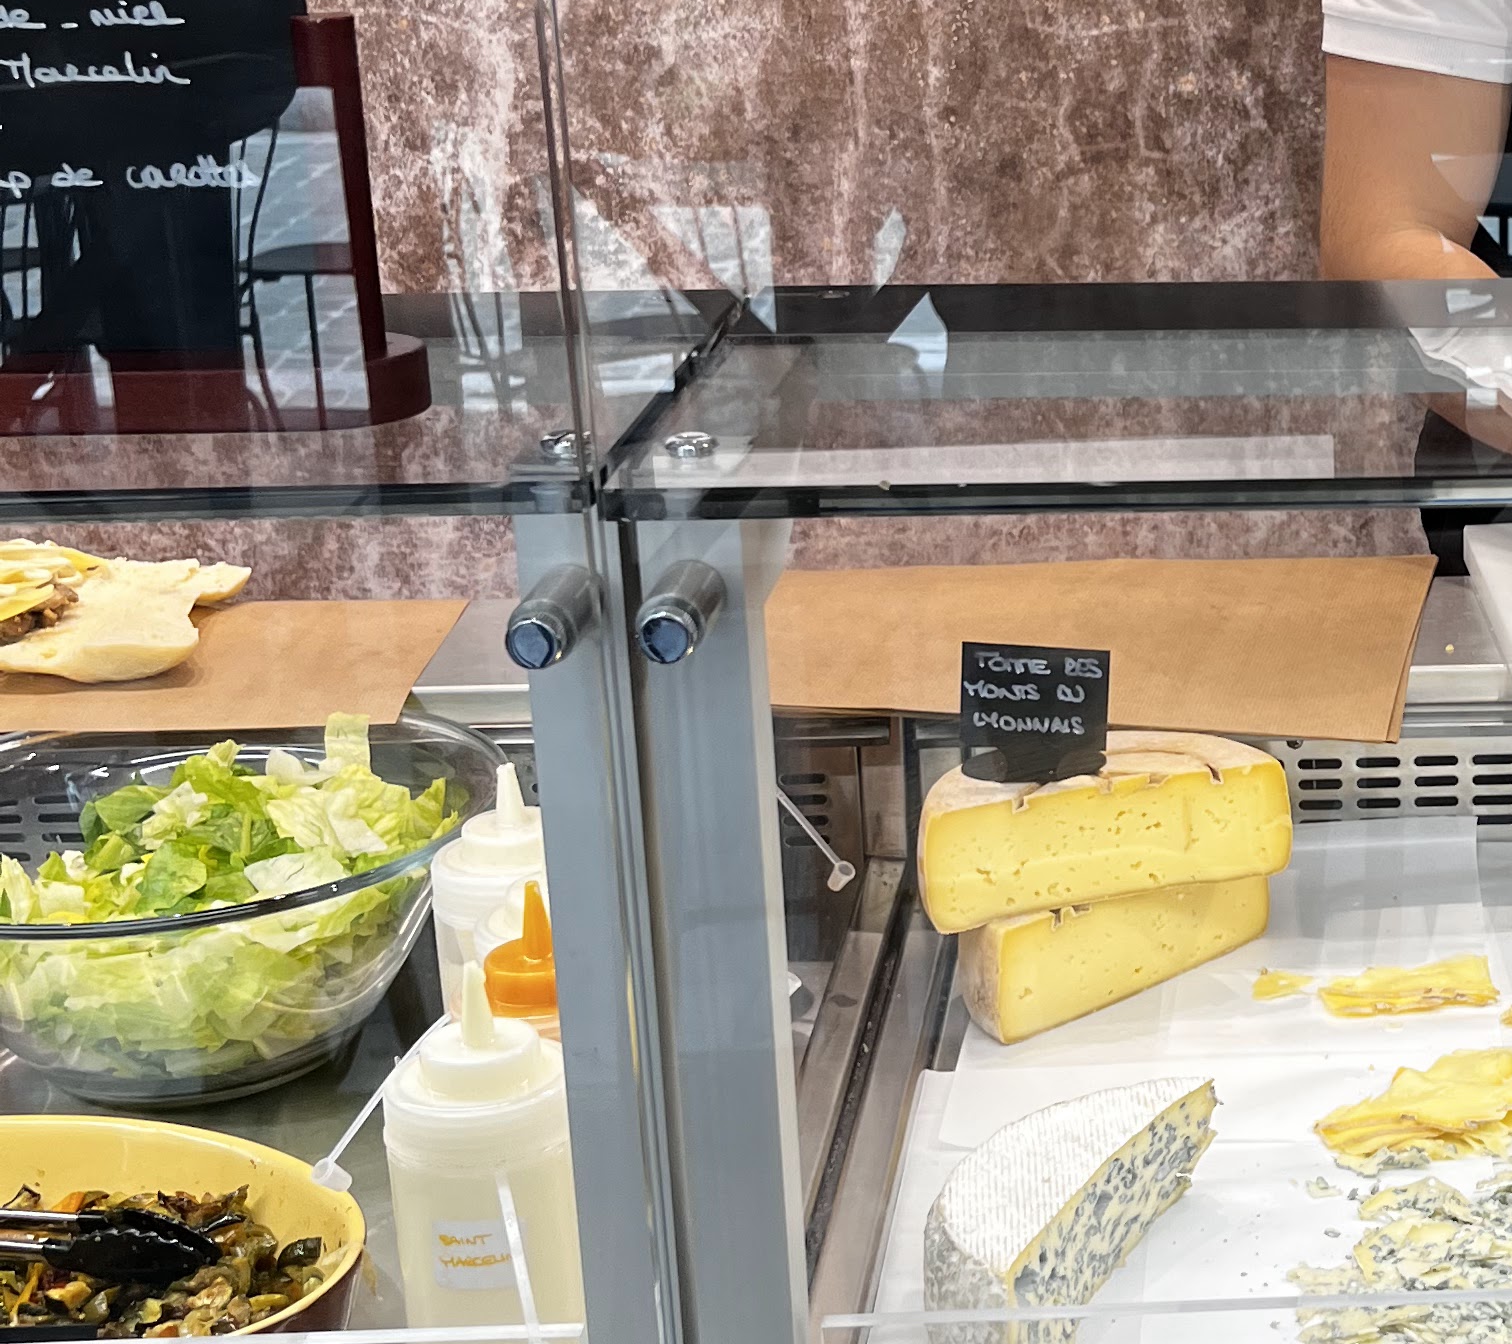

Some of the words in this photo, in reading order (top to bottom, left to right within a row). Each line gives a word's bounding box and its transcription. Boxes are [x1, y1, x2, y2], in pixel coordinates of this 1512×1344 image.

[51, 163, 103, 187] de
[1064, 657, 1103, 679] DES
[973, 711, 1085, 735] LYONNAIS
